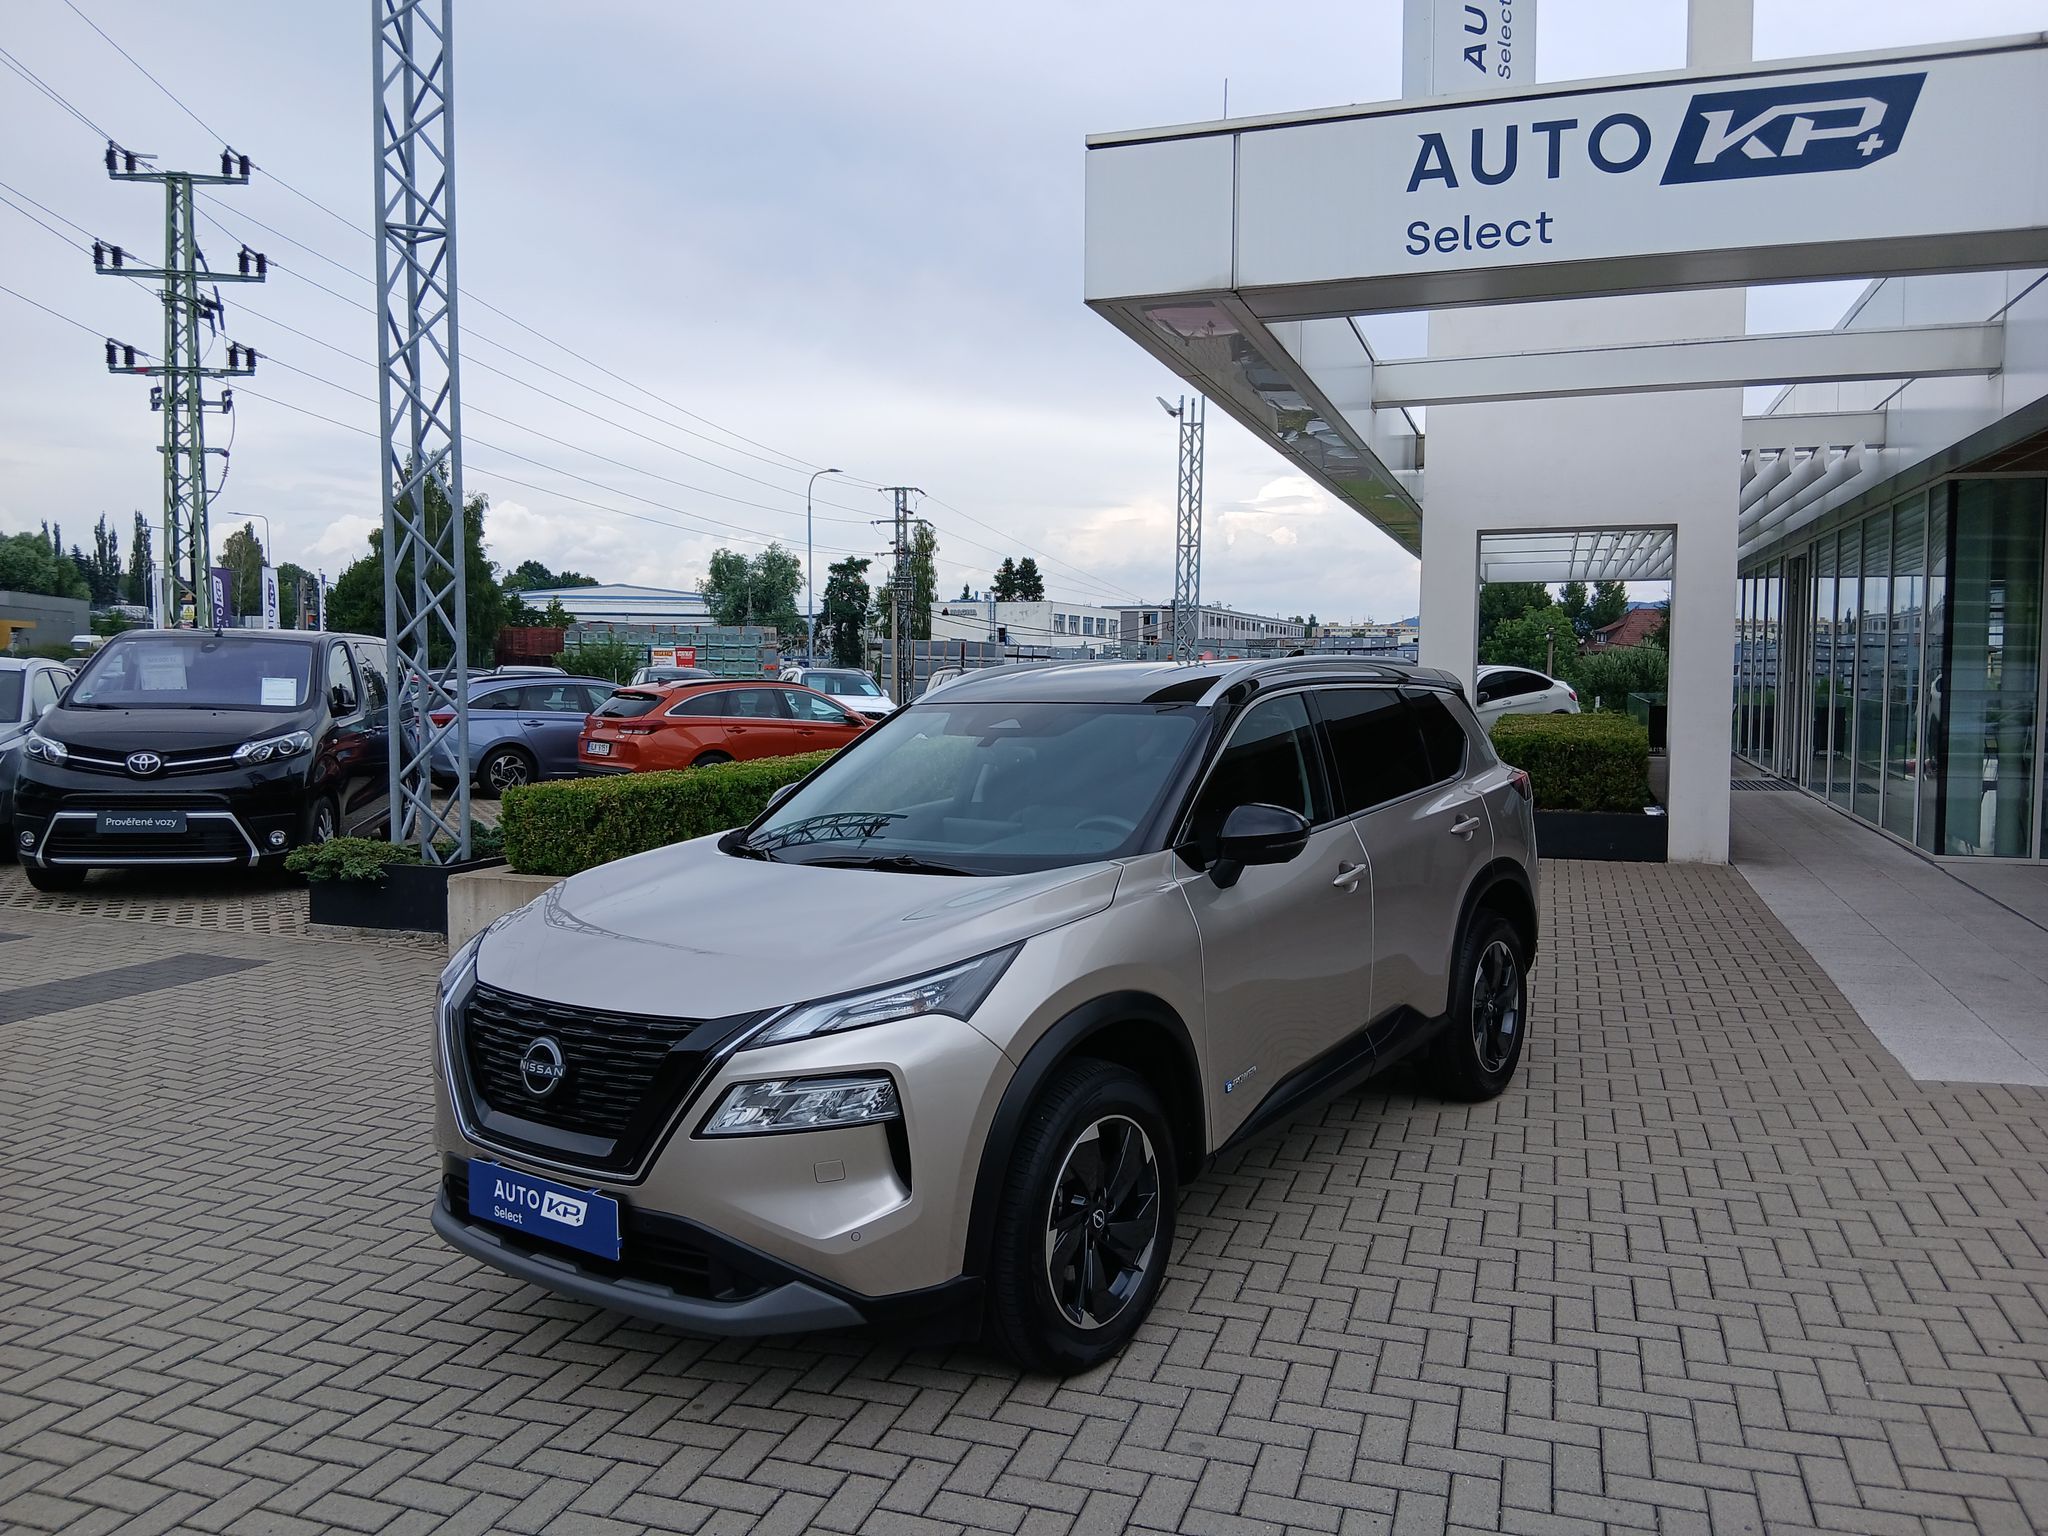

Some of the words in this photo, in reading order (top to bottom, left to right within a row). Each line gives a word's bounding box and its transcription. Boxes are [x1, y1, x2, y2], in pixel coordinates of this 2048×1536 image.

[1406, 112, 1652, 192] AUTO
[1406, 212, 1553, 256] Select
[105, 817, 153, 826] Prověřené
[155, 819, 177, 828] vozy
[520, 1058, 563, 1077] NISSAN
[494, 1179, 540, 1209] AUTO
[494, 1204, 523, 1225] Select
